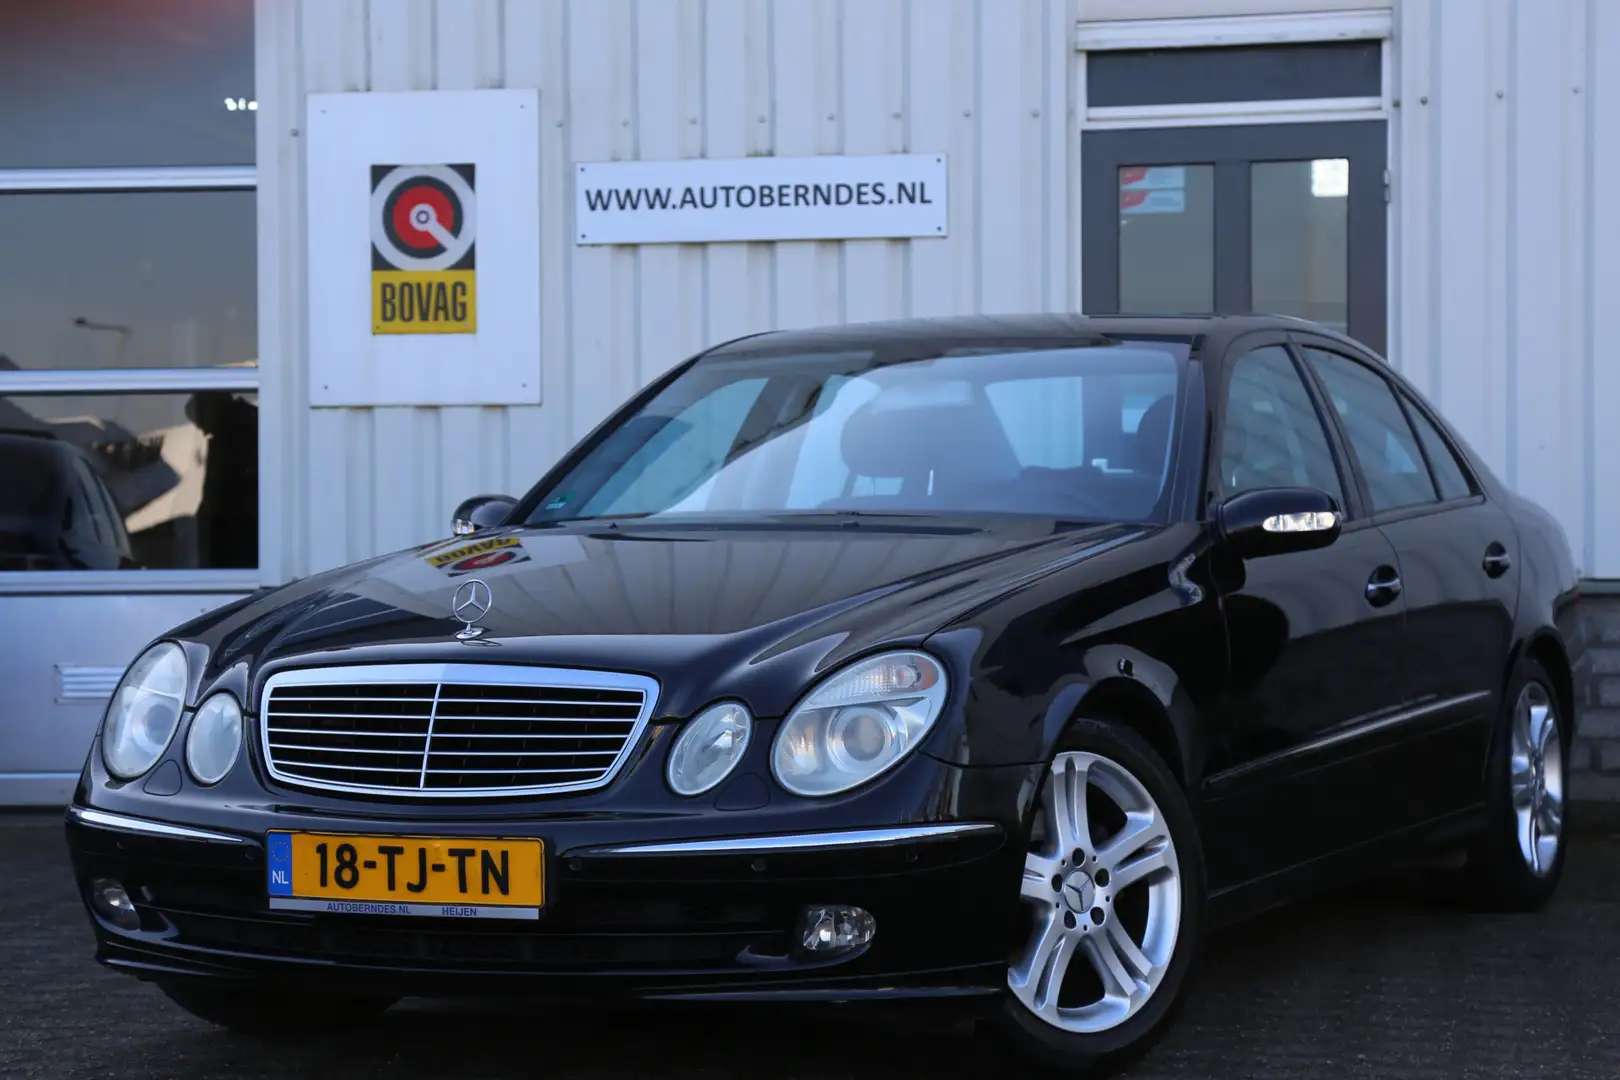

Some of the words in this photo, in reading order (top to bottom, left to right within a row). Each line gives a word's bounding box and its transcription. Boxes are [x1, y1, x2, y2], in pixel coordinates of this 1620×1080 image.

[585, 181, 932, 211] WWW.AUTOBERNDES.NL
[381, 281, 467, 322] BOVAG
[272, 871, 289, 885] NL
[316, 843, 510, 896] 18-TJ-TN
[327, 902, 411, 915] AUTOBERNDES.NL
[442, 907, 477, 917] HEIJEN
